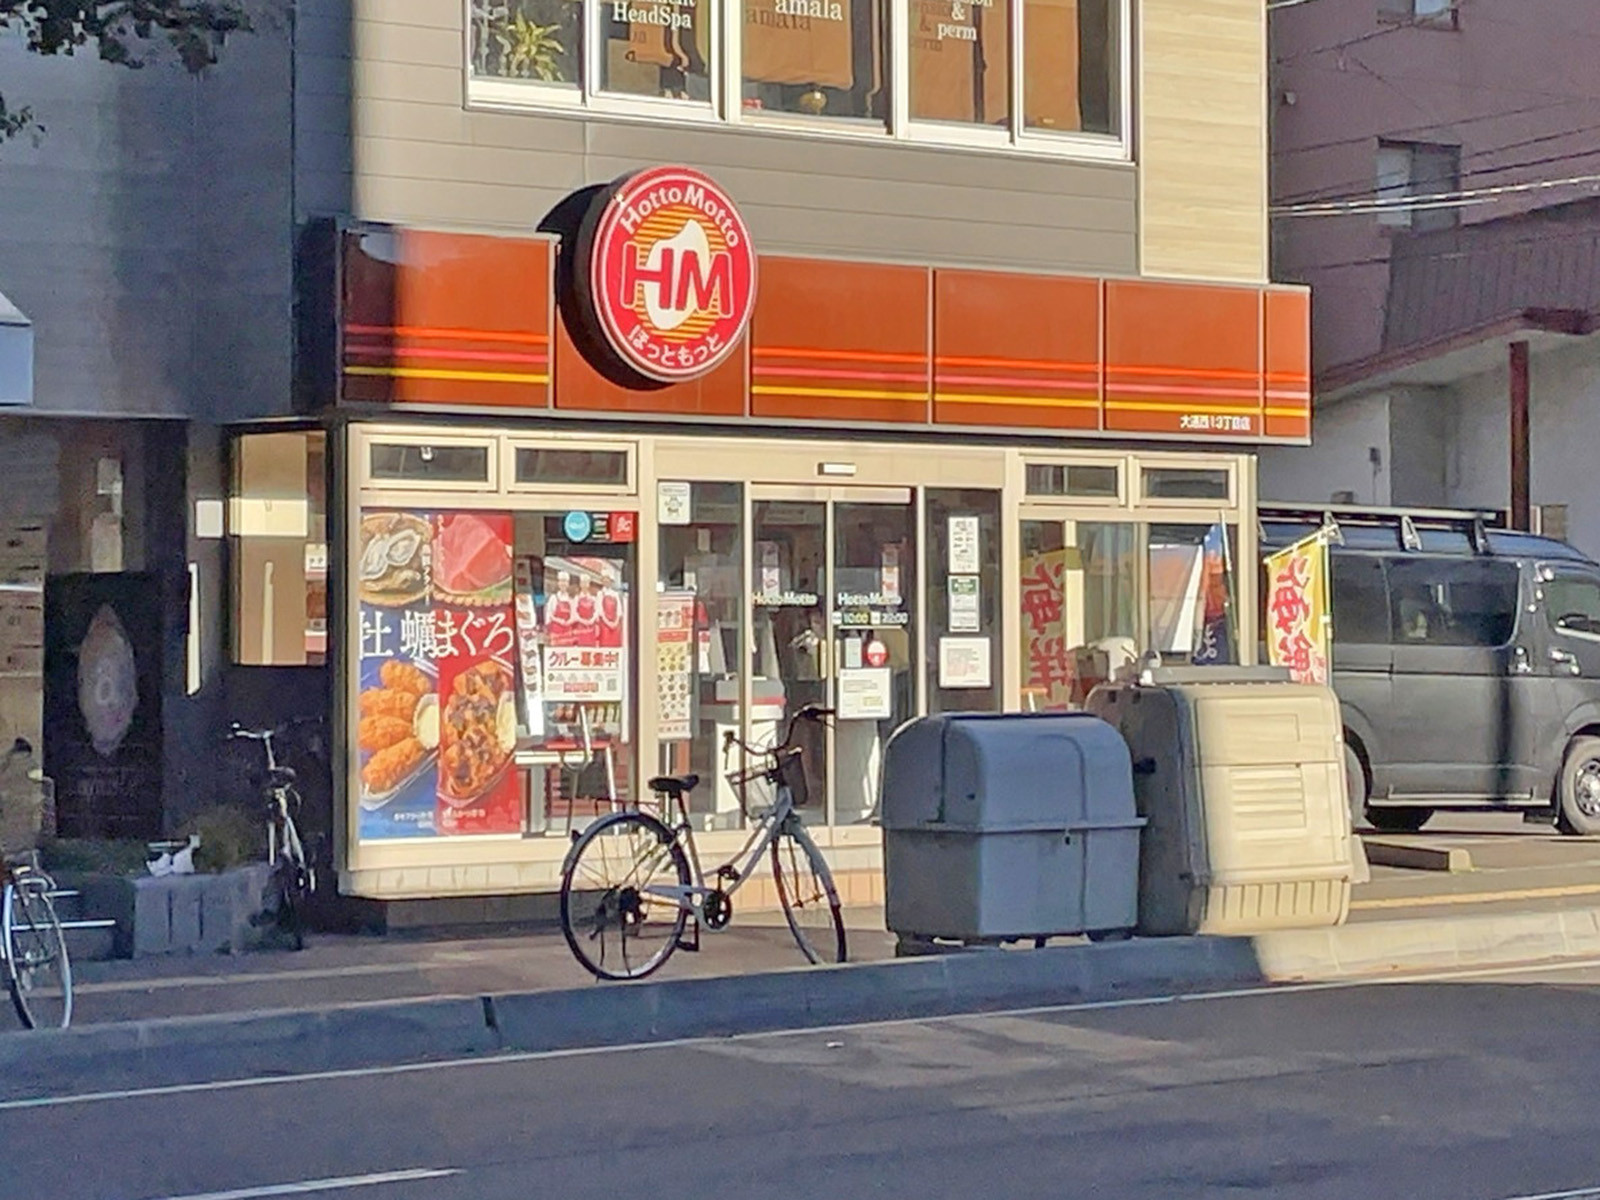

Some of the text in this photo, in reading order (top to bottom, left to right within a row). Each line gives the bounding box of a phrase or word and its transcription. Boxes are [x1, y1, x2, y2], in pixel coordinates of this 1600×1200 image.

[612, 1, 692, 30] HeadSpa
[775, 0, 843, 21] amala
[951, 1, 965, 20] &
[937, 23, 977, 41] perm
[627, 324, 723, 367] ほっともっと
[428, 610, 514, 658] まぐろ
